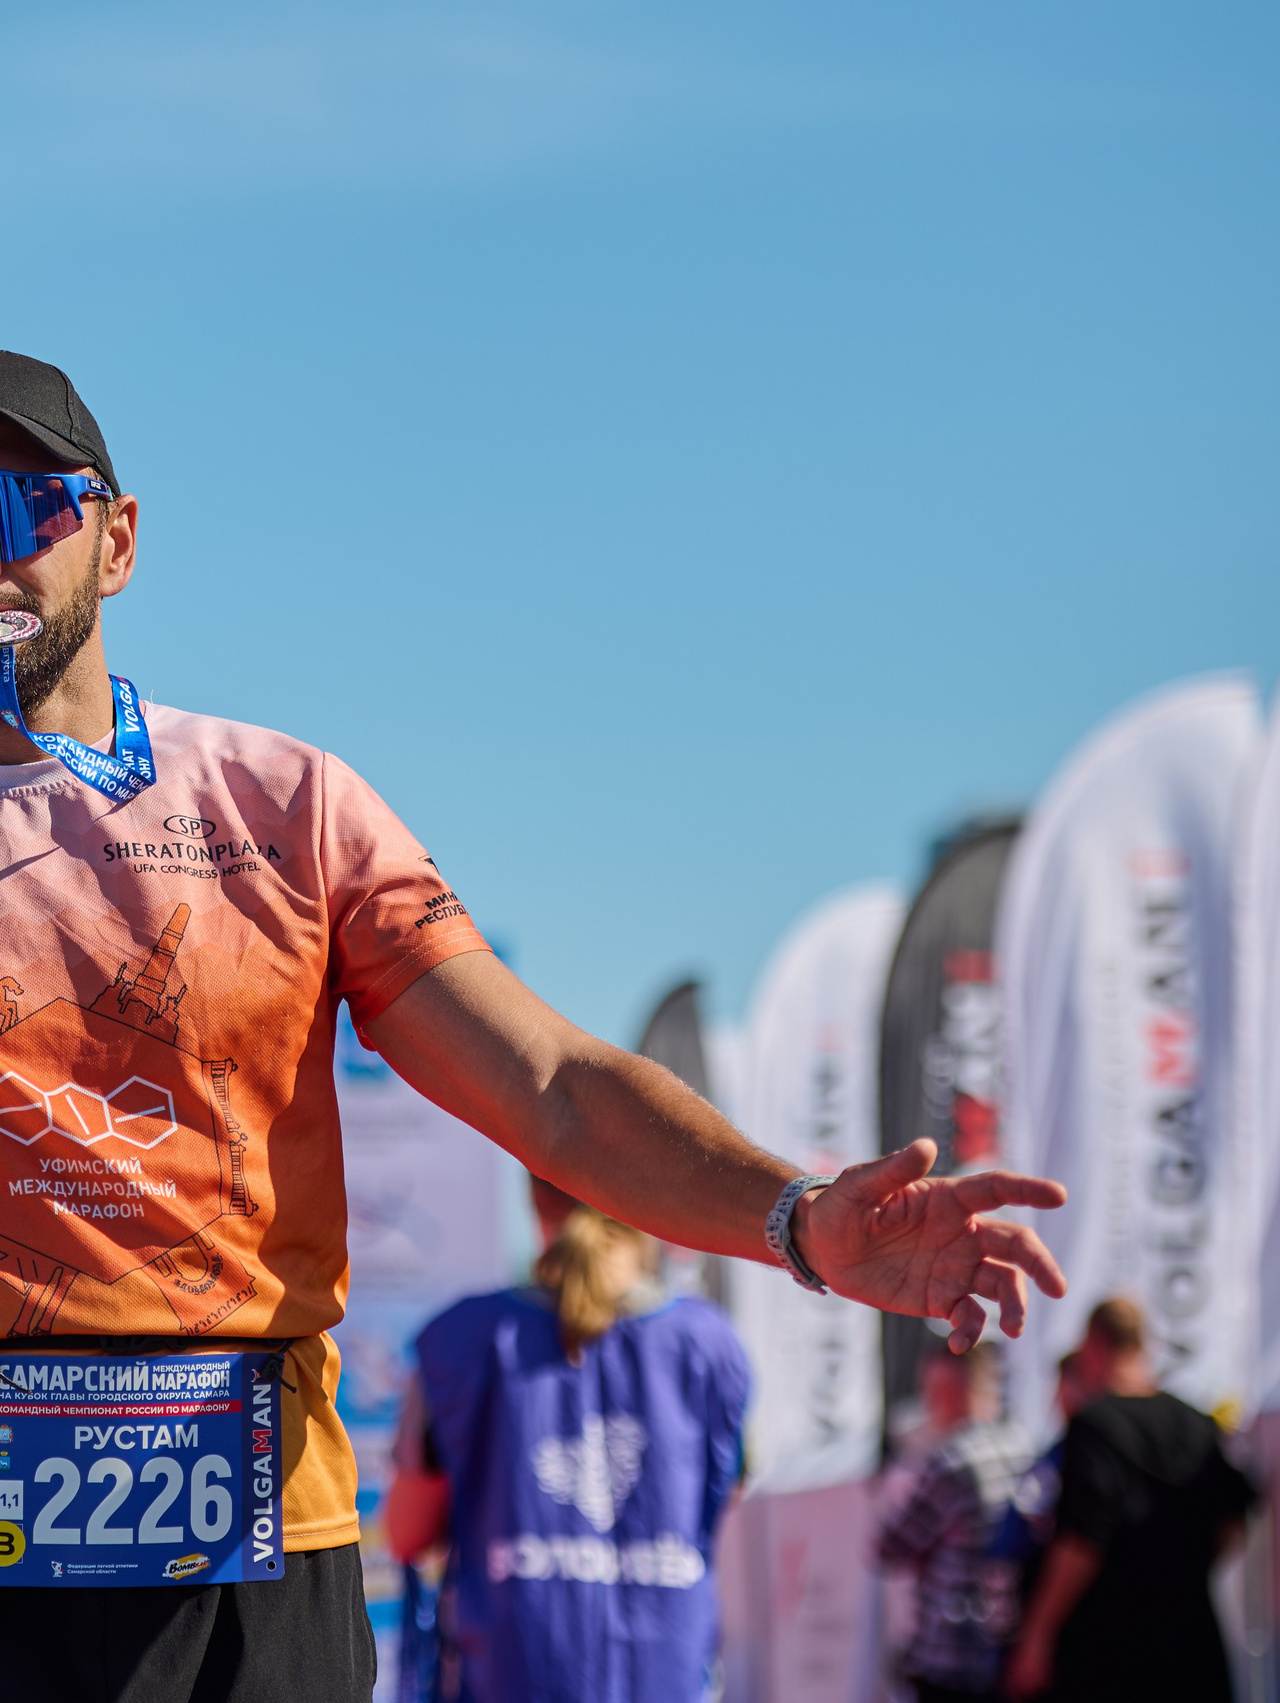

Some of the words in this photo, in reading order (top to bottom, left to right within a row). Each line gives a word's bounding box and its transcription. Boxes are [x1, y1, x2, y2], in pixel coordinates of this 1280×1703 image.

[1, 646, 11, 683] вгуста
[33, 735, 129, 782] КОМАНДНЫЙ
[46, 743, 99, 781] РОССИИ
[98, 774, 117, 793] ПО
[179, 818, 201, 836] SP
[134, 863, 157, 874] UFA
[160, 864, 218, 879] CONGRESS
[222, 861, 262, 878] HOTEL
[39, 1156, 143, 1175] УФИМСКИЙ
[8, 1178, 177, 1199] МЕЖДУНАРОДНЫЙ
[53, 1200, 145, 1219] МАРАФОН
[152, 1361, 230, 1373] МЕЖДУНАРОДНЫЙ
[152, 1370, 230, 1391] МАРАФОН
[14, 1392, 48, 1400] КУБОК
[50, 1392, 85, 1401] ГЛАВЫ
[88, 1393, 154, 1402] ГОРОДСКОГО
[155, 1391, 192, 1400] ОКРУГА
[193, 1389, 230, 1399] САМАРА
[63, 1406, 124, 1415] ЧЕМПИОНАТ
[125, 1406, 163, 1415] РОССИИ
[165, 1405, 180, 1414] ПО
[181, 1403, 230, 1414] МАРАФОНУ
[74, 1424, 199, 1450] РУСТАМ
[252, 1384, 274, 1562] VOLGAMAN
[33, 1454, 233, 1545] 2226
